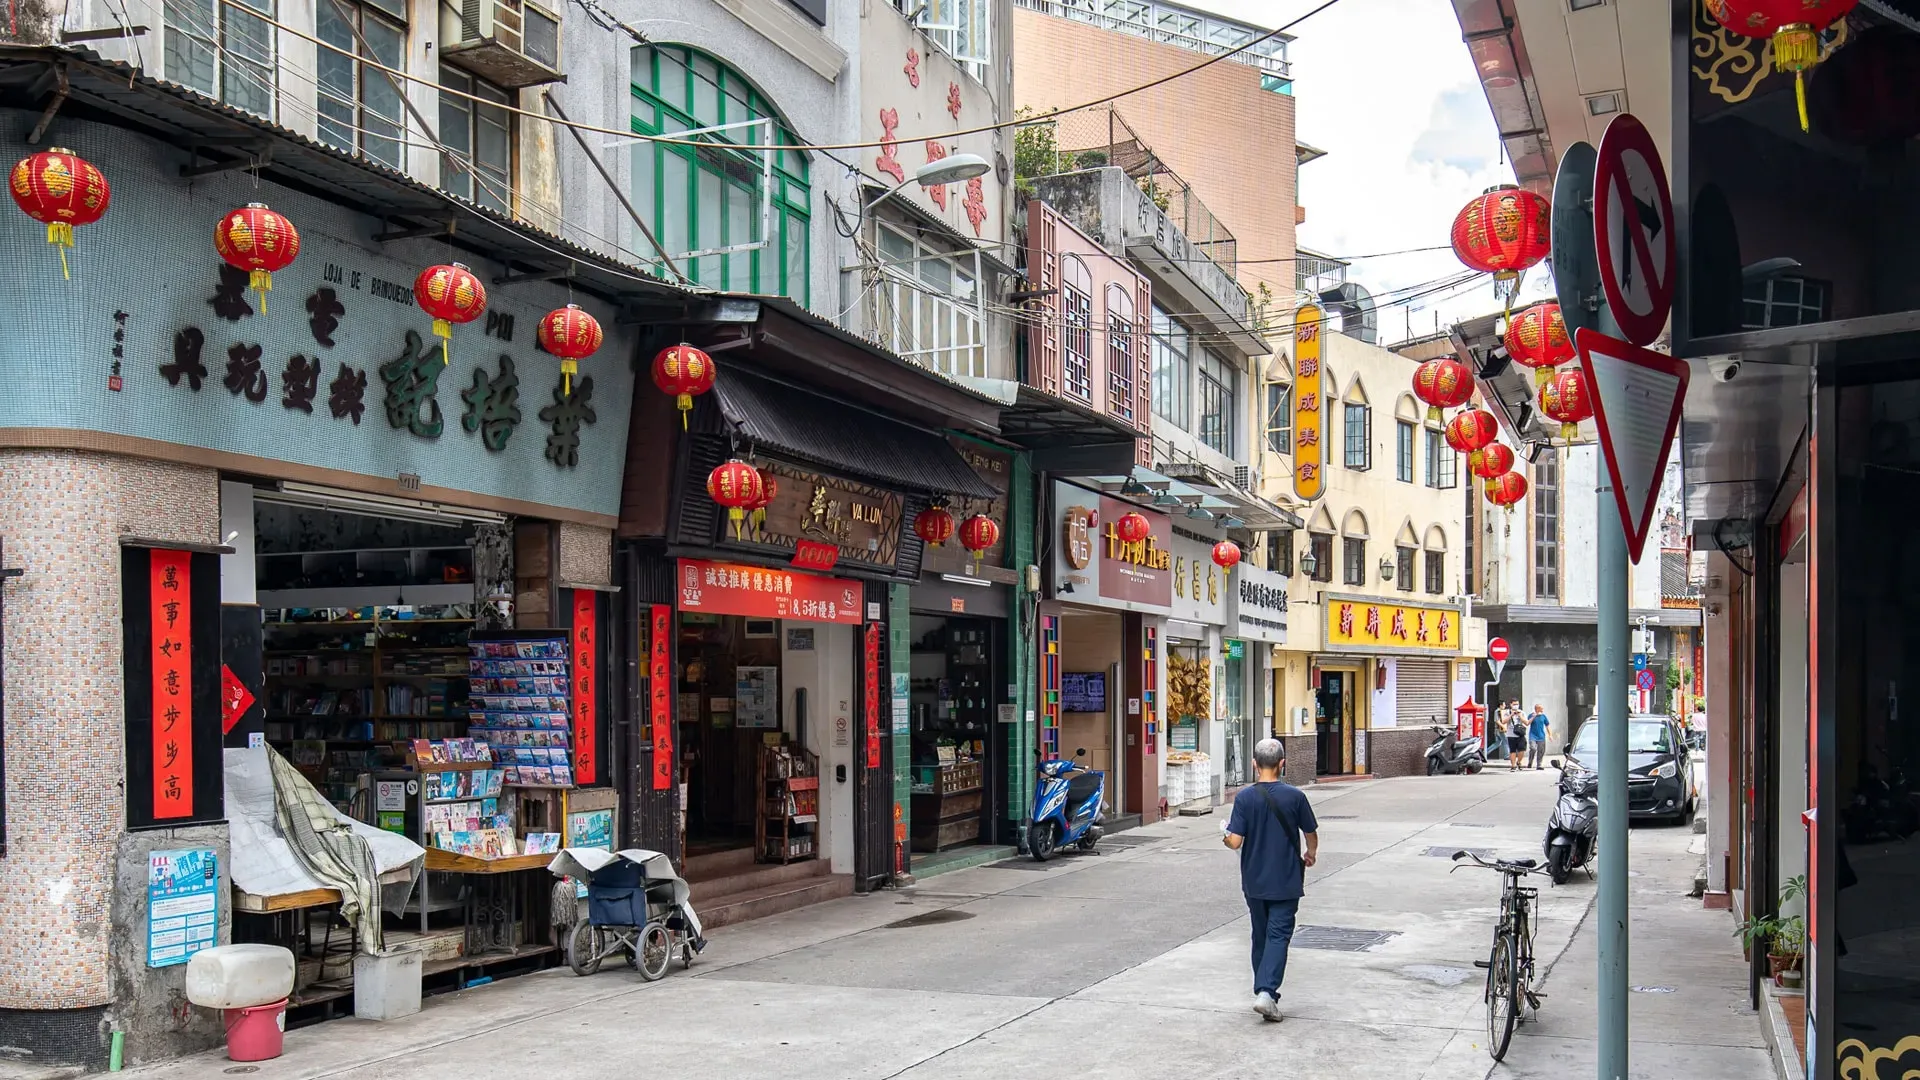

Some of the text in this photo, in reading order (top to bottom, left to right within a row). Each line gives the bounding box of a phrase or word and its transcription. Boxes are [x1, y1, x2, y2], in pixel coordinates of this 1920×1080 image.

[323, 261, 415, 307] LOJA DE BRINQUEDOS
[1297, 323, 1319, 482] 新聯成美食
[864, 505, 884, 525] LUN
[159, 565, 182, 802] 萬事如意步步高
[577, 604, 592, 774] 一帆風順年年好
